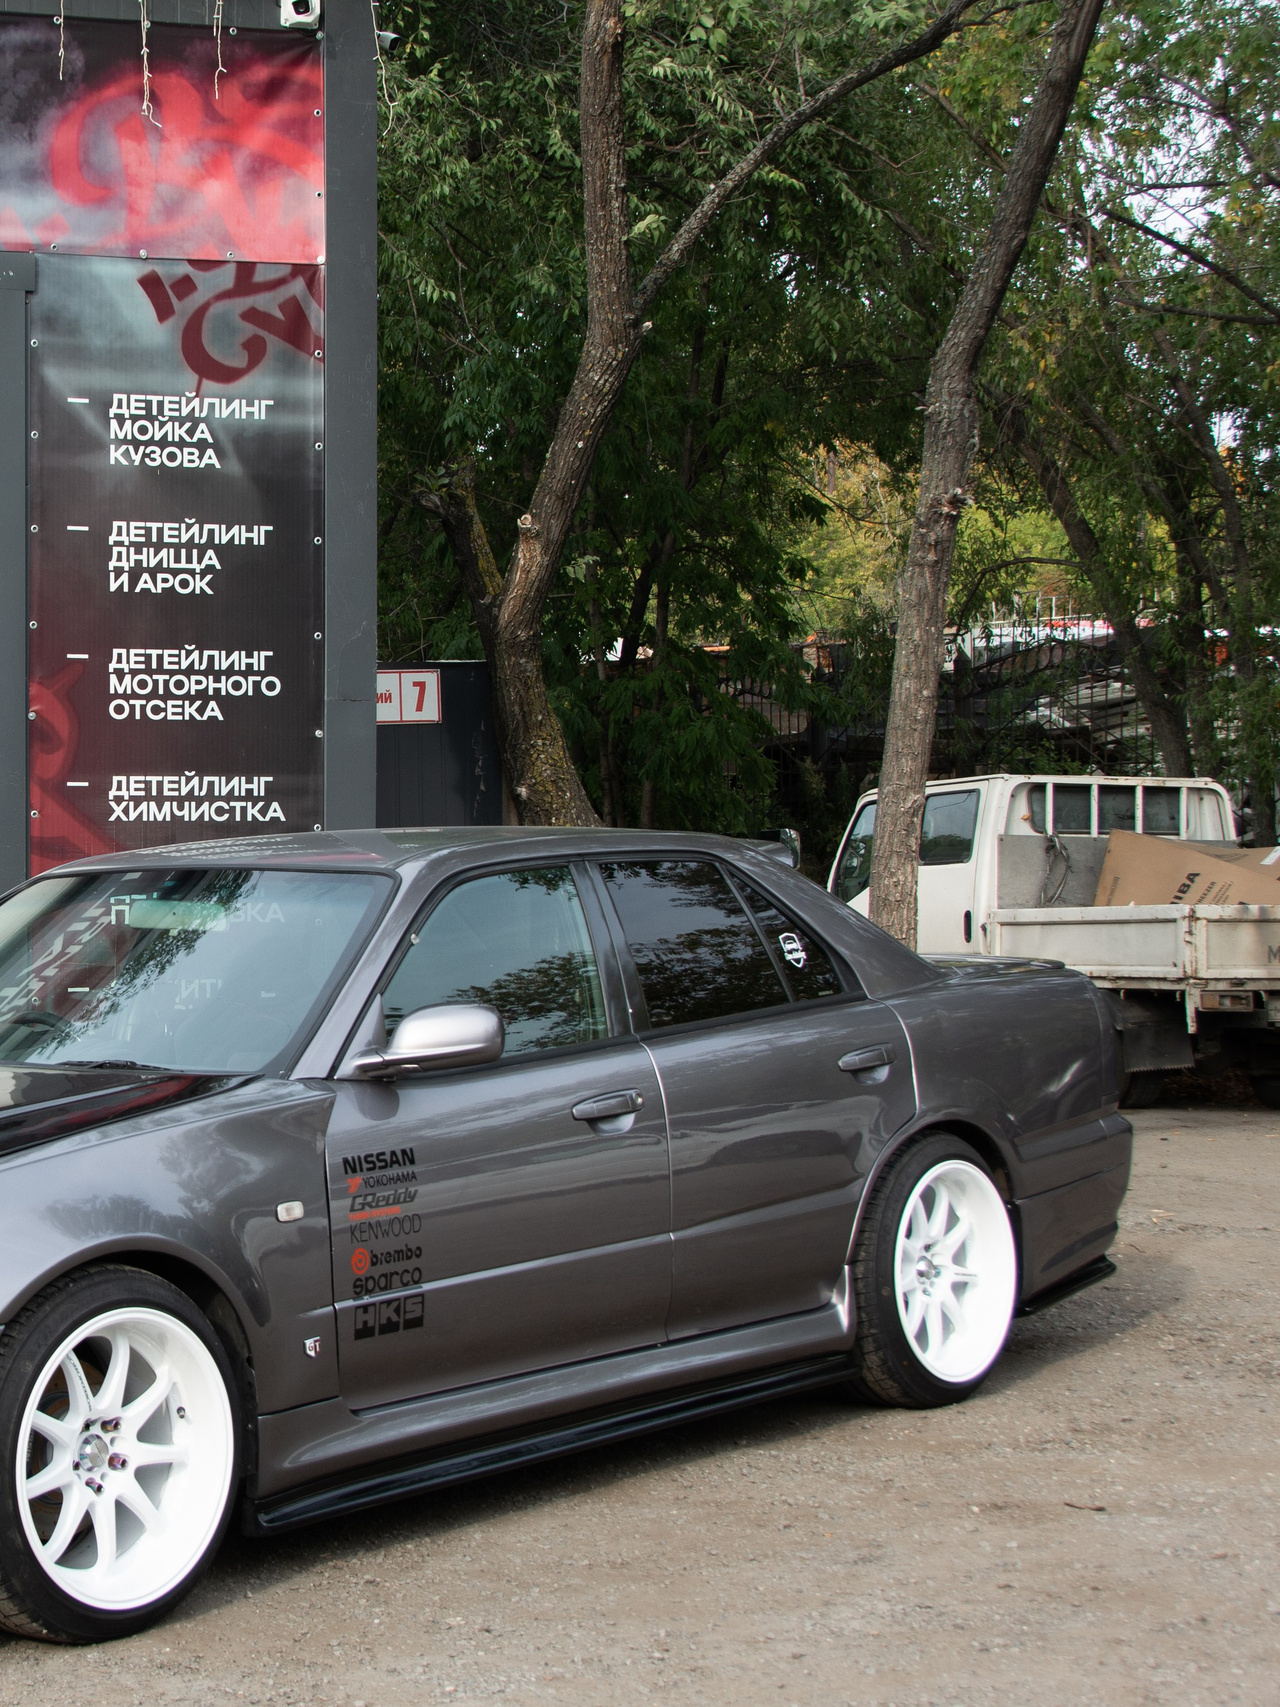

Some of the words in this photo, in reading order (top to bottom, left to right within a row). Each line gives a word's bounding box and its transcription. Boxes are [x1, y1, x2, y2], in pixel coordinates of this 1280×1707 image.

[109, 391, 274, 420] ДЕТЕЙЛИНГ
[110, 416, 213, 443] МОЙКА
[110, 444, 221, 469] КУЗОВА
[109, 518, 273, 546] ДЕТЕЙЛИНГ
[109, 547, 221, 571] ДНИЩА
[109, 573, 128, 593] И
[135, 573, 214, 595] АРОК
[109, 645, 273, 672] ДЕТЕЙЛИНГ
[110, 674, 281, 697] МОТОРНОГО
[412, 681, 426, 712] 7
[109, 698, 223, 721] ОТСЕКА
[109, 773, 273, 800] ДЕТЕЙЛИНГ
[109, 800, 285, 822] ХИМЧИСТКА
[1170, 873, 1200, 904] IBA
[342, 1147, 415, 1174] NISSAN
[362, 1170, 417, 1189] YOKOHAMA
[349, 1187, 418, 1212] GReddy
[350, 1213, 421, 1244] KENWOOD
[370, 1243, 422, 1267] brembo
[353, 1267, 422, 1295] sparco
[354, 1293, 424, 1340] HKS
